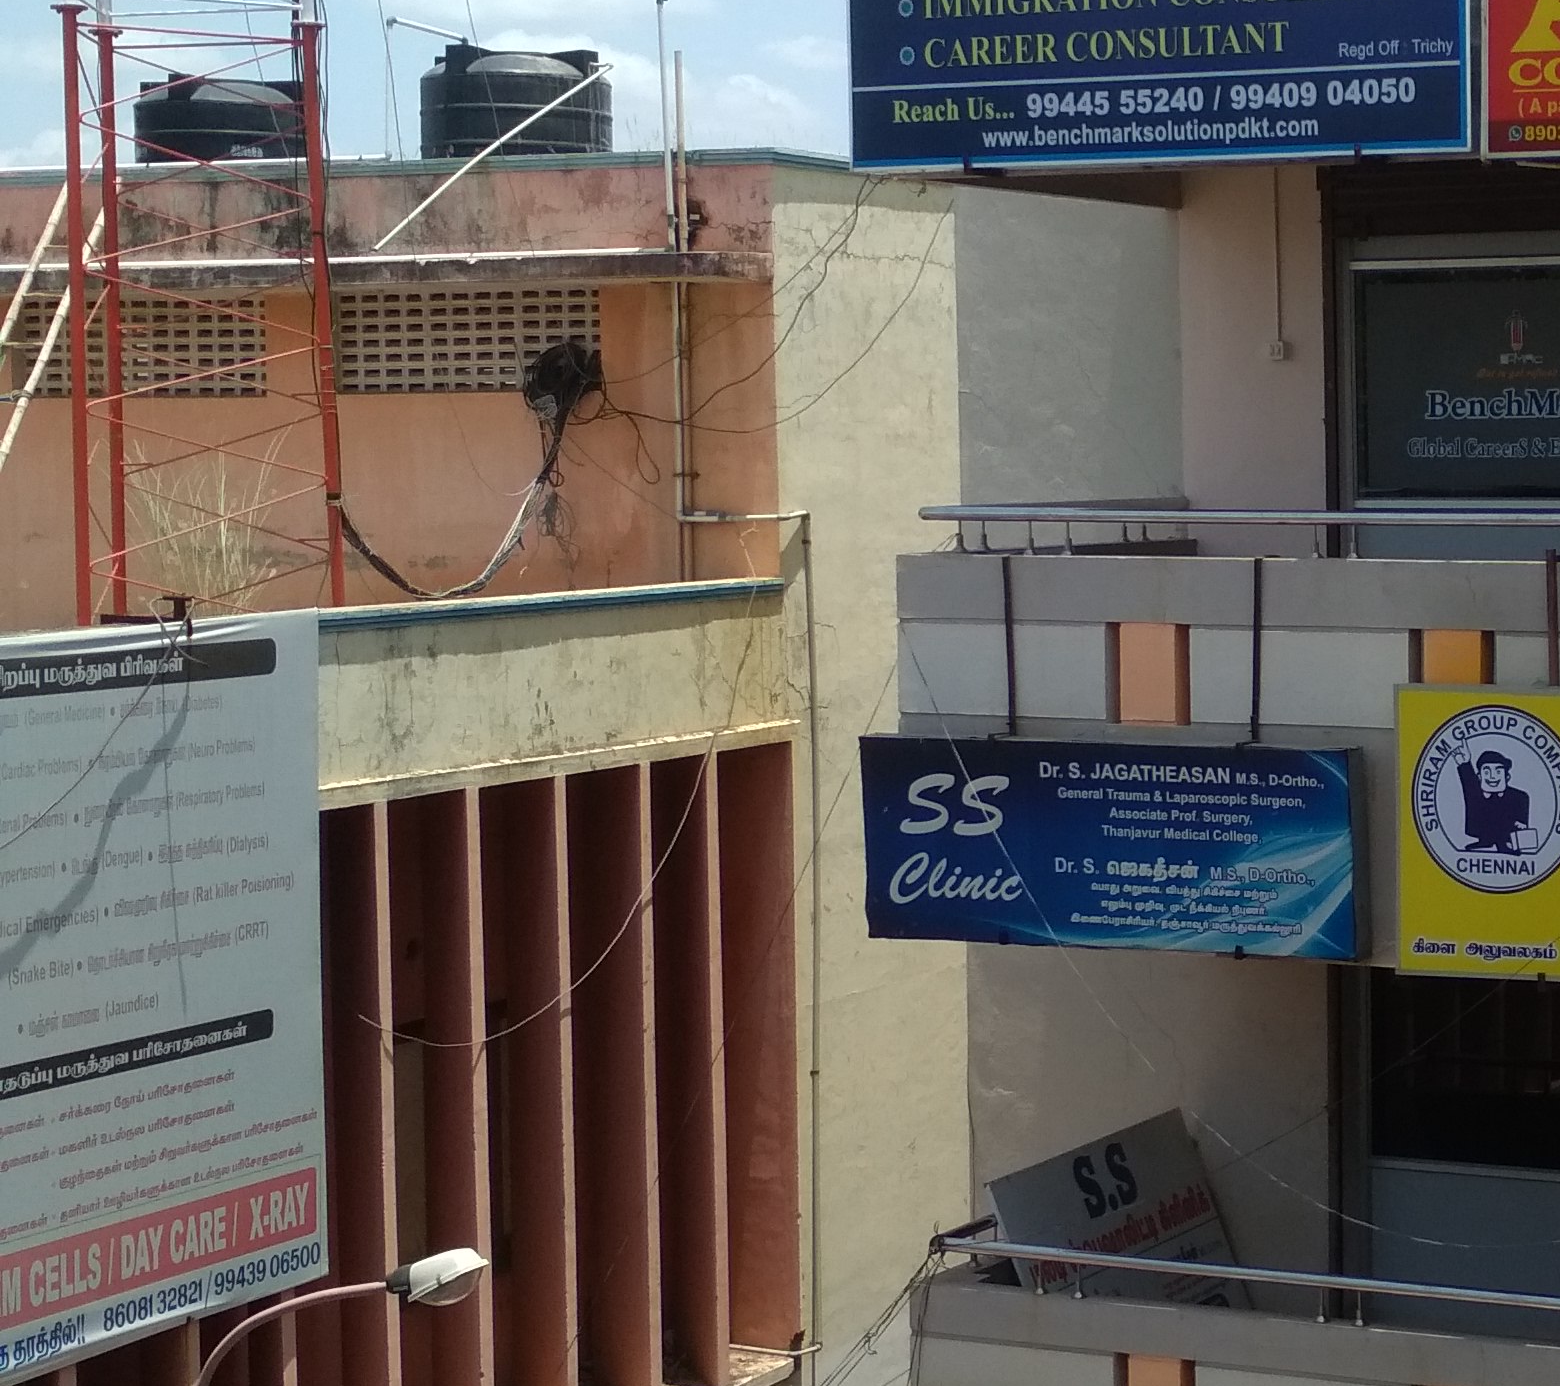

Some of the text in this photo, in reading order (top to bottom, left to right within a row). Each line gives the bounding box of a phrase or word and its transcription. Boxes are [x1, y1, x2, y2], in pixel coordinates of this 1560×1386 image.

[924, 22, 1289, 68] CAREER CONSULTANT
[1339, 38, 1453, 59] Regd Trichy
[892, 78, 1416, 124] Reach 99445 55240 99409 04050
[982, 118, 1319, 149] www.benchmarksolutionpdkt.com
[1408, 437, 1461, 458] Global
[1532, 438, 1546, 457] &
[1039, 762, 1230, 784] Dr. S. JAGATHEASAN
[1420, 742, 1452, 833] SHRIRAM
[1451, 716, 1518, 742] GROUP
[900, 773, 1009, 837] SS
[1057, 786, 1306, 810] General Trauma & Laparoscopic Surgeon,
[1109, 807, 1253, 826] Associate Surgery,
[1101, 825, 1209, 842] Thanjavur Medical
[889, 852, 1022, 904] Clinic
[1054, 858, 1099, 875] Dr. S.
[1456, 857, 1536, 877] CHENNAI
[215, 881, 239, 898] killer
[30, 1182, 309, 1306] CELLS DAY CARE X-RAY
[103, 1242, 320, 1332] 86081 32821 99439 06500
